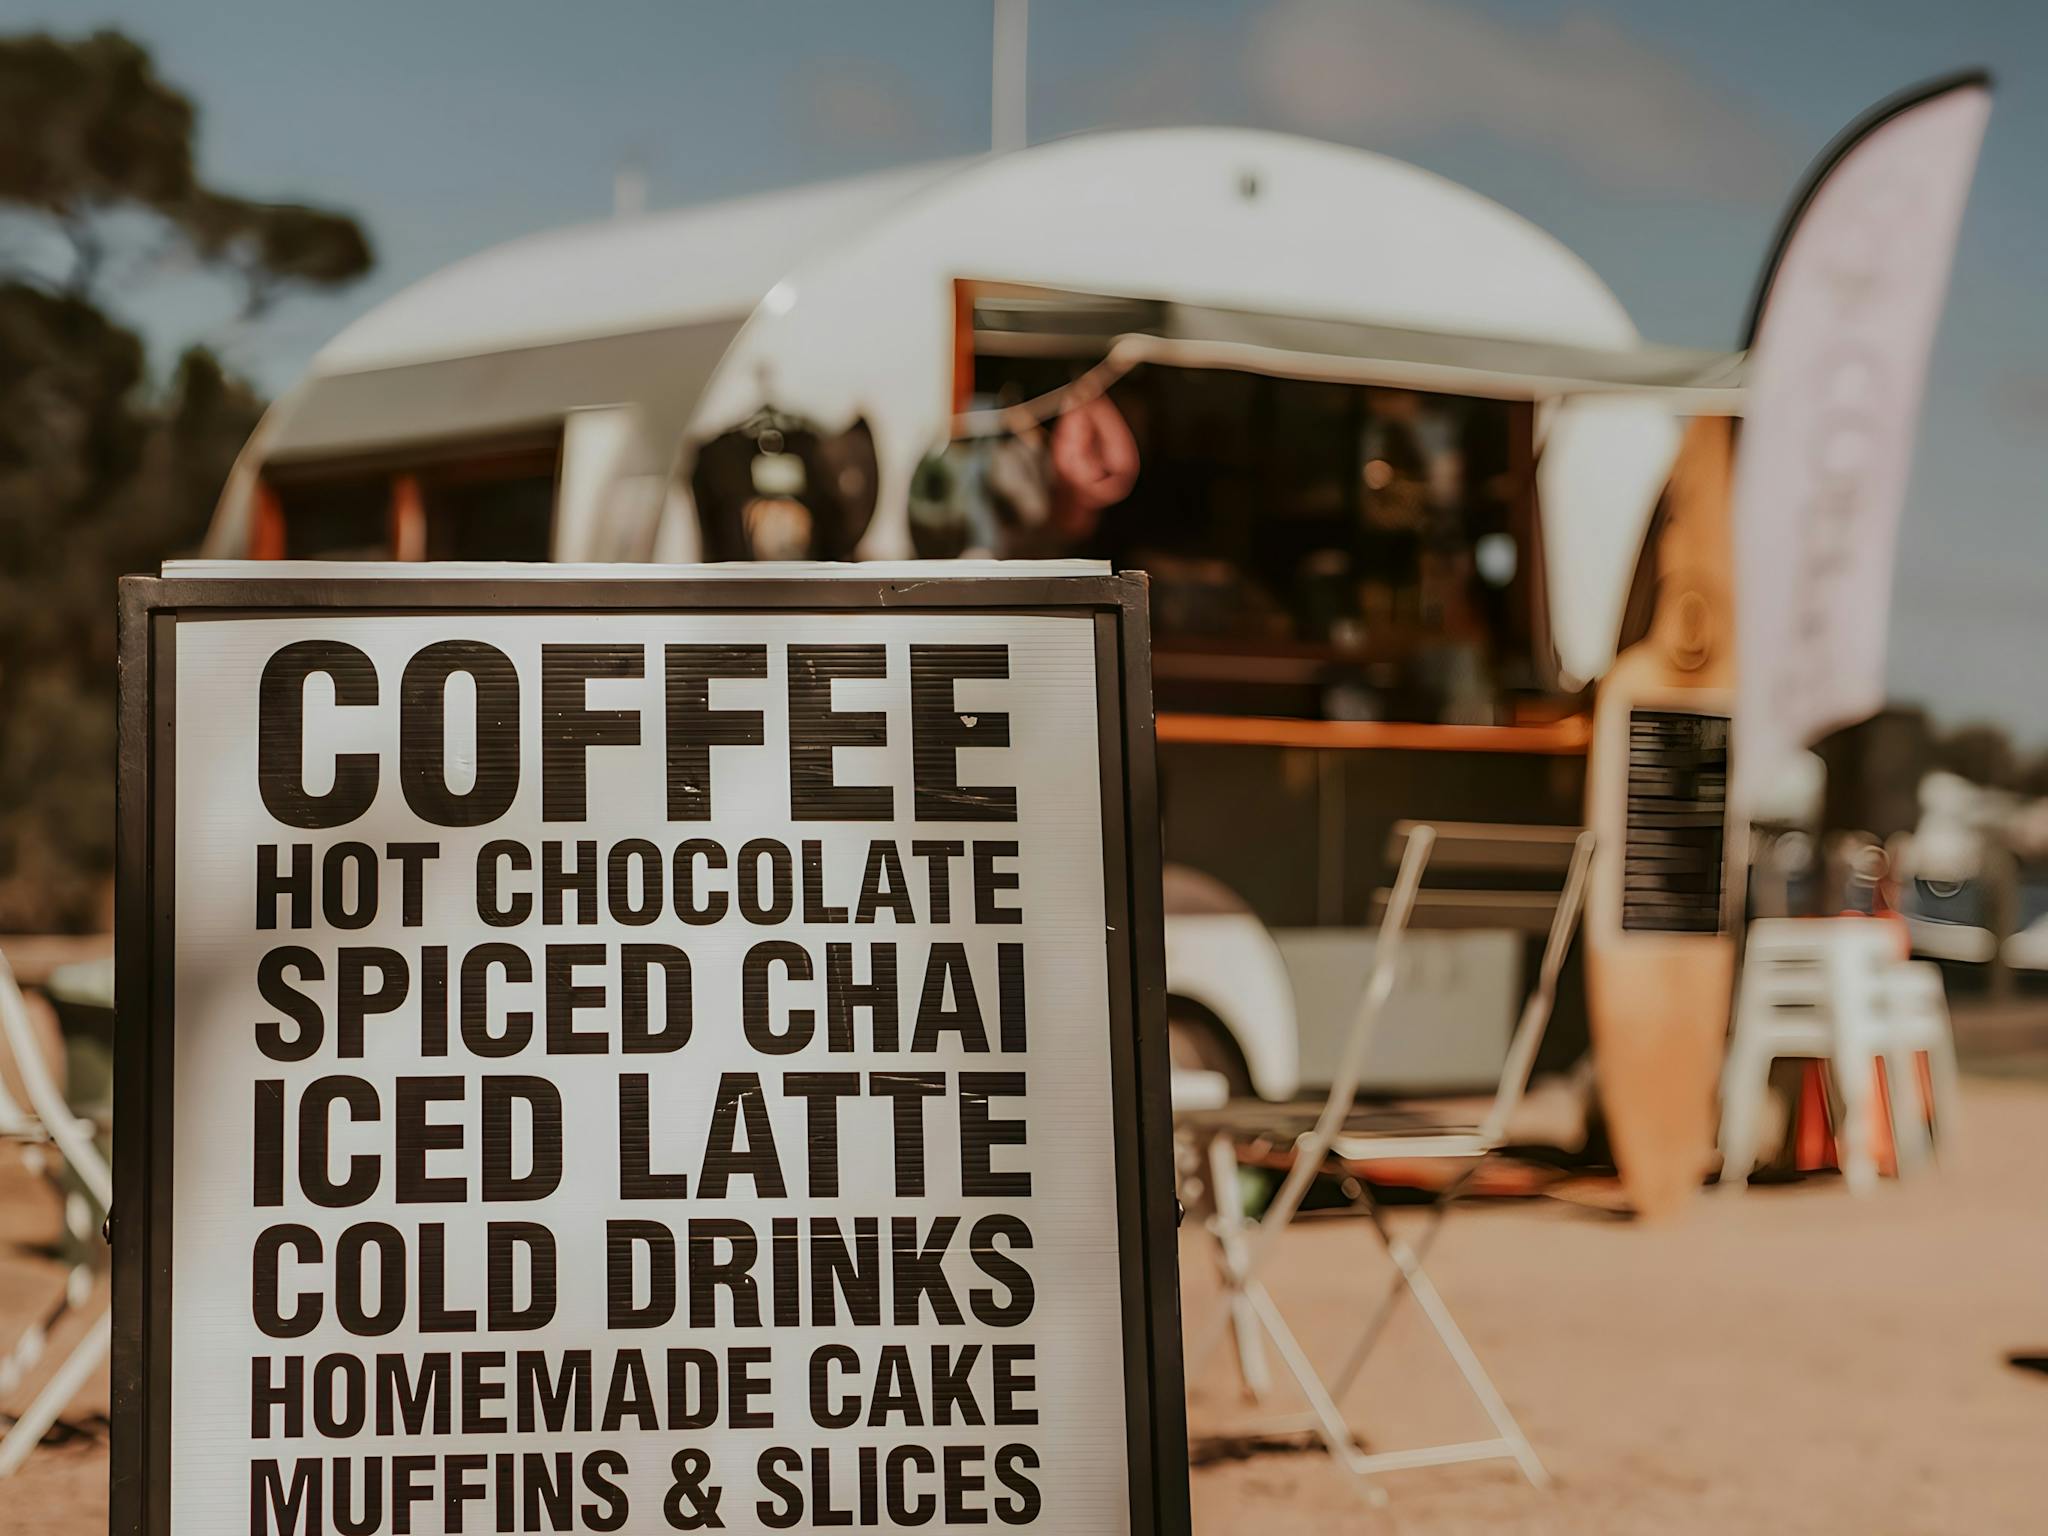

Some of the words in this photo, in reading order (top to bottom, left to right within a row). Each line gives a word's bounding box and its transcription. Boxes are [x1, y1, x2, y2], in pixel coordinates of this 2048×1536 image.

[258, 640, 1018, 829] COFFEE
[256, 842, 440, 930] HOT
[477, 838, 1022, 927] CHOCOLATE
[255, 943, 692, 1062] SPICED
[743, 941, 1027, 1055] CHAI
[254, 1075, 562, 1208] ICED
[619, 1072, 1032, 1200] LATTE
[253, 1222, 556, 1338] COLD
[607, 1214, 1035, 1329] DRINKS
[252, 1347, 773, 1439] HOMEMADE
[809, 1344, 1038, 1429] CAKE
[251, 1450, 629, 1536] MUFFINS
[664, 1448, 726, 1530] &
[756, 1443, 1041, 1528] SLICES
